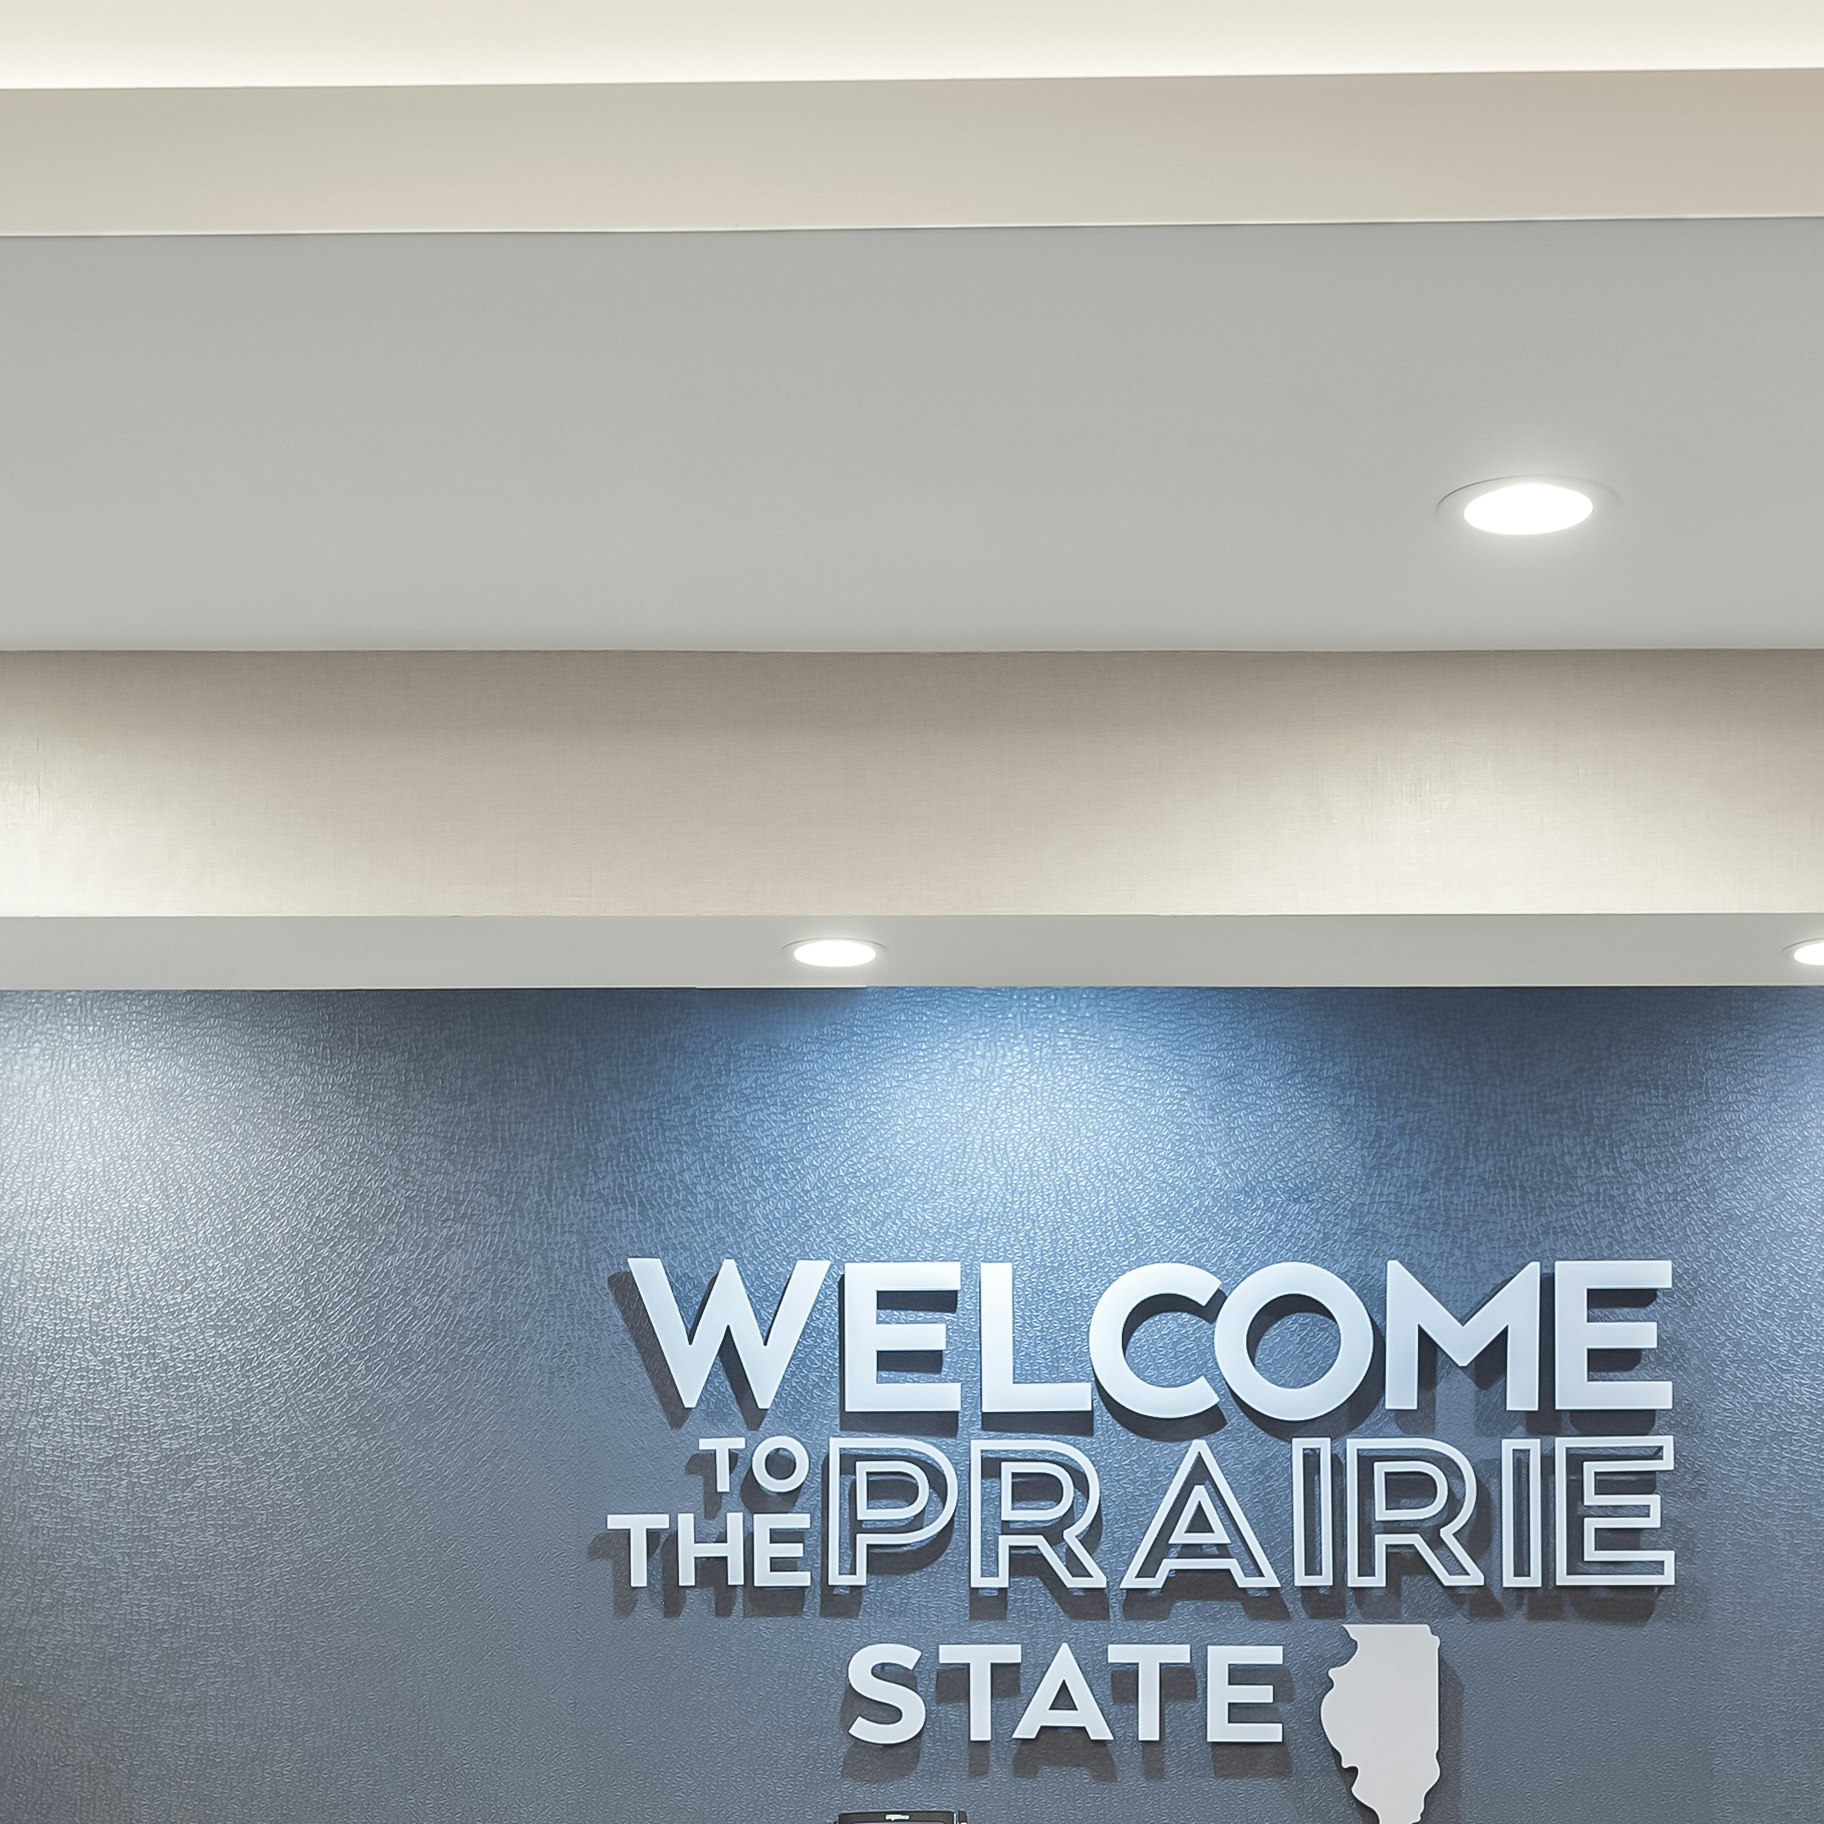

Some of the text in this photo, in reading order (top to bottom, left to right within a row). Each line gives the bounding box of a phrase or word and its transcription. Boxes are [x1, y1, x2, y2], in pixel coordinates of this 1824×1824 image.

[627, 1257, 1673, 1420] WELCOME
[607, 1435, 1676, 1588] THE PRAIRIE
[699, 1436, 810, 1493] TO
[847, 1643, 1284, 1745] STATE
